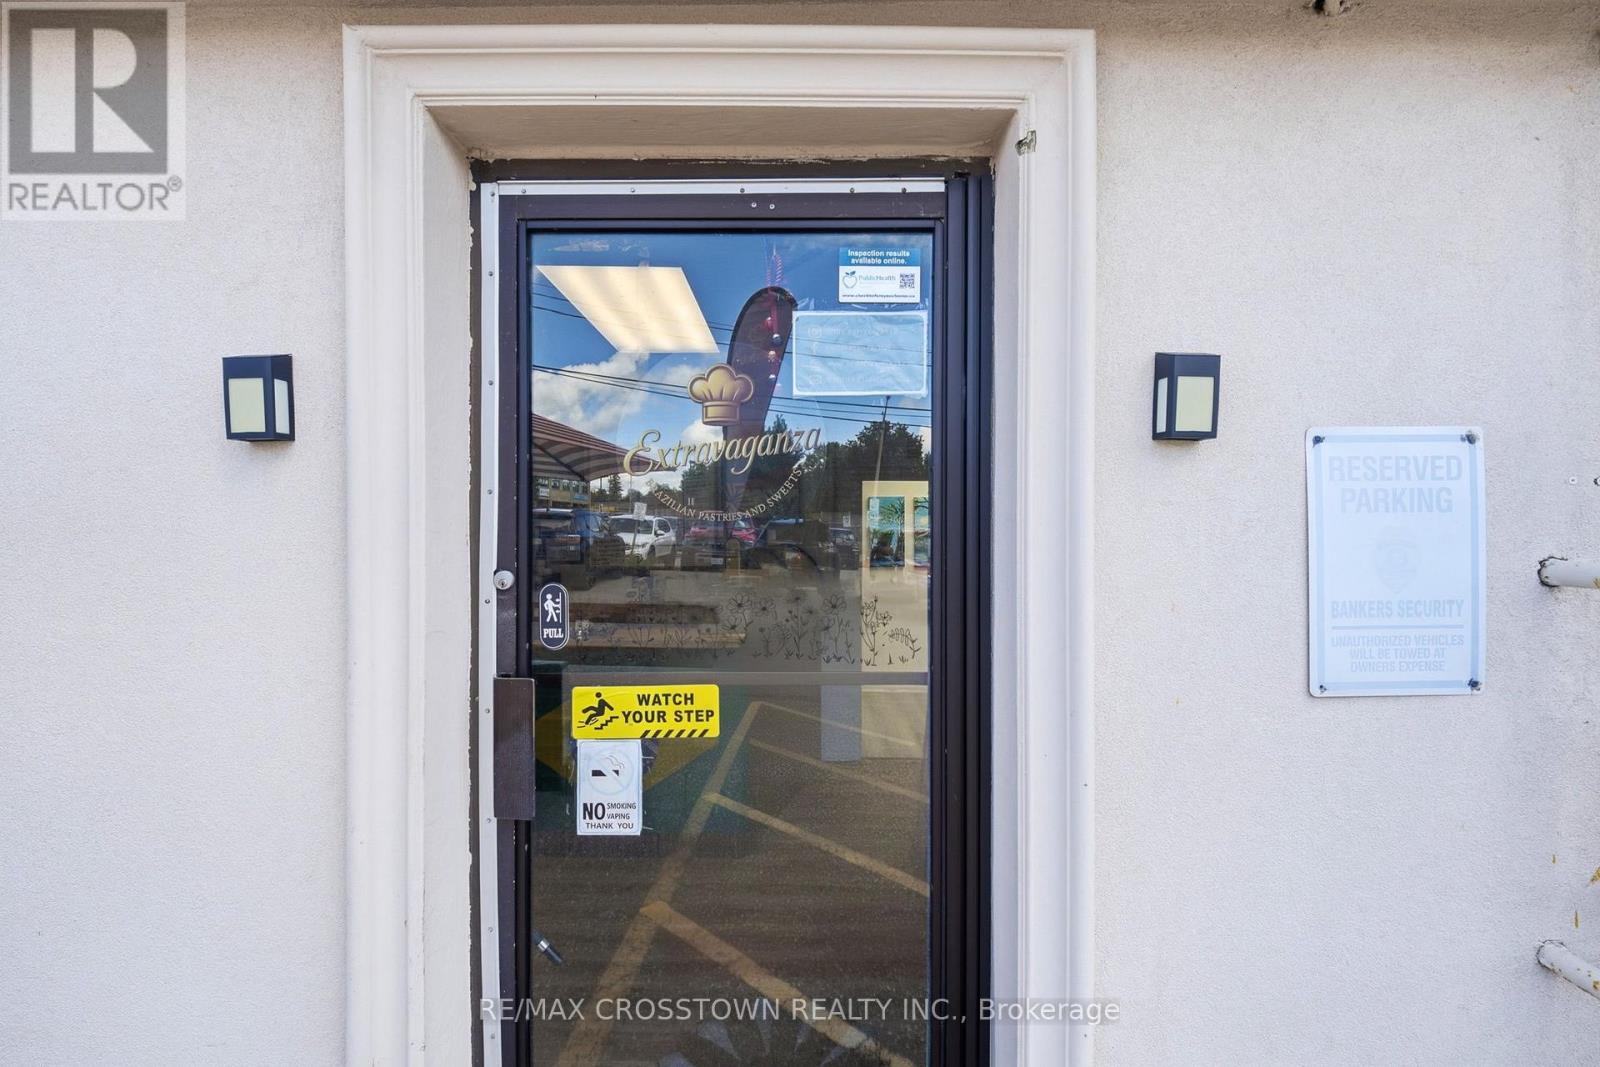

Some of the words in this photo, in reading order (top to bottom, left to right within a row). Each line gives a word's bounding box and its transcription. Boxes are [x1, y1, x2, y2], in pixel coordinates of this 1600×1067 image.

[848, 249, 884, 258] Inspection
[886, 249, 910, 257] results
[623, 427, 821, 476] Extravaganza
[1328, 455, 1464, 482] RESERVED
[698, 510, 747, 522] PASTRIES
[744, 502, 767, 519] AND
[767, 466, 803, 507] SWEETS
[1340, 486, 1453, 513] PARKING
[1331, 601, 1393, 619] BANKERS
[1397, 600, 1464, 618] SECURITY
[543, 628, 564, 639] PULL
[1331, 634, 1412, 647] UNAUTHORIZED
[1413, 633, 1465, 646] VEHICLES
[1349, 648, 1375, 660] WILL
[1377, 648, 1391, 660] BE
[1394, 648, 1430, 660] TOWED
[1433, 647, 1447, 659] AT
[1350, 660, 1396, 673] OWNERS
[1398, 660, 1446, 672] EXPENSE
[637, 693, 695, 706] WATCH
[622, 710, 666, 723] YOUR
[673, 709, 715, 723] STEP
[582, 802, 606, 820] NO
[607, 802, 637, 810] SMOKING
[585, 822, 613, 830] THANK
